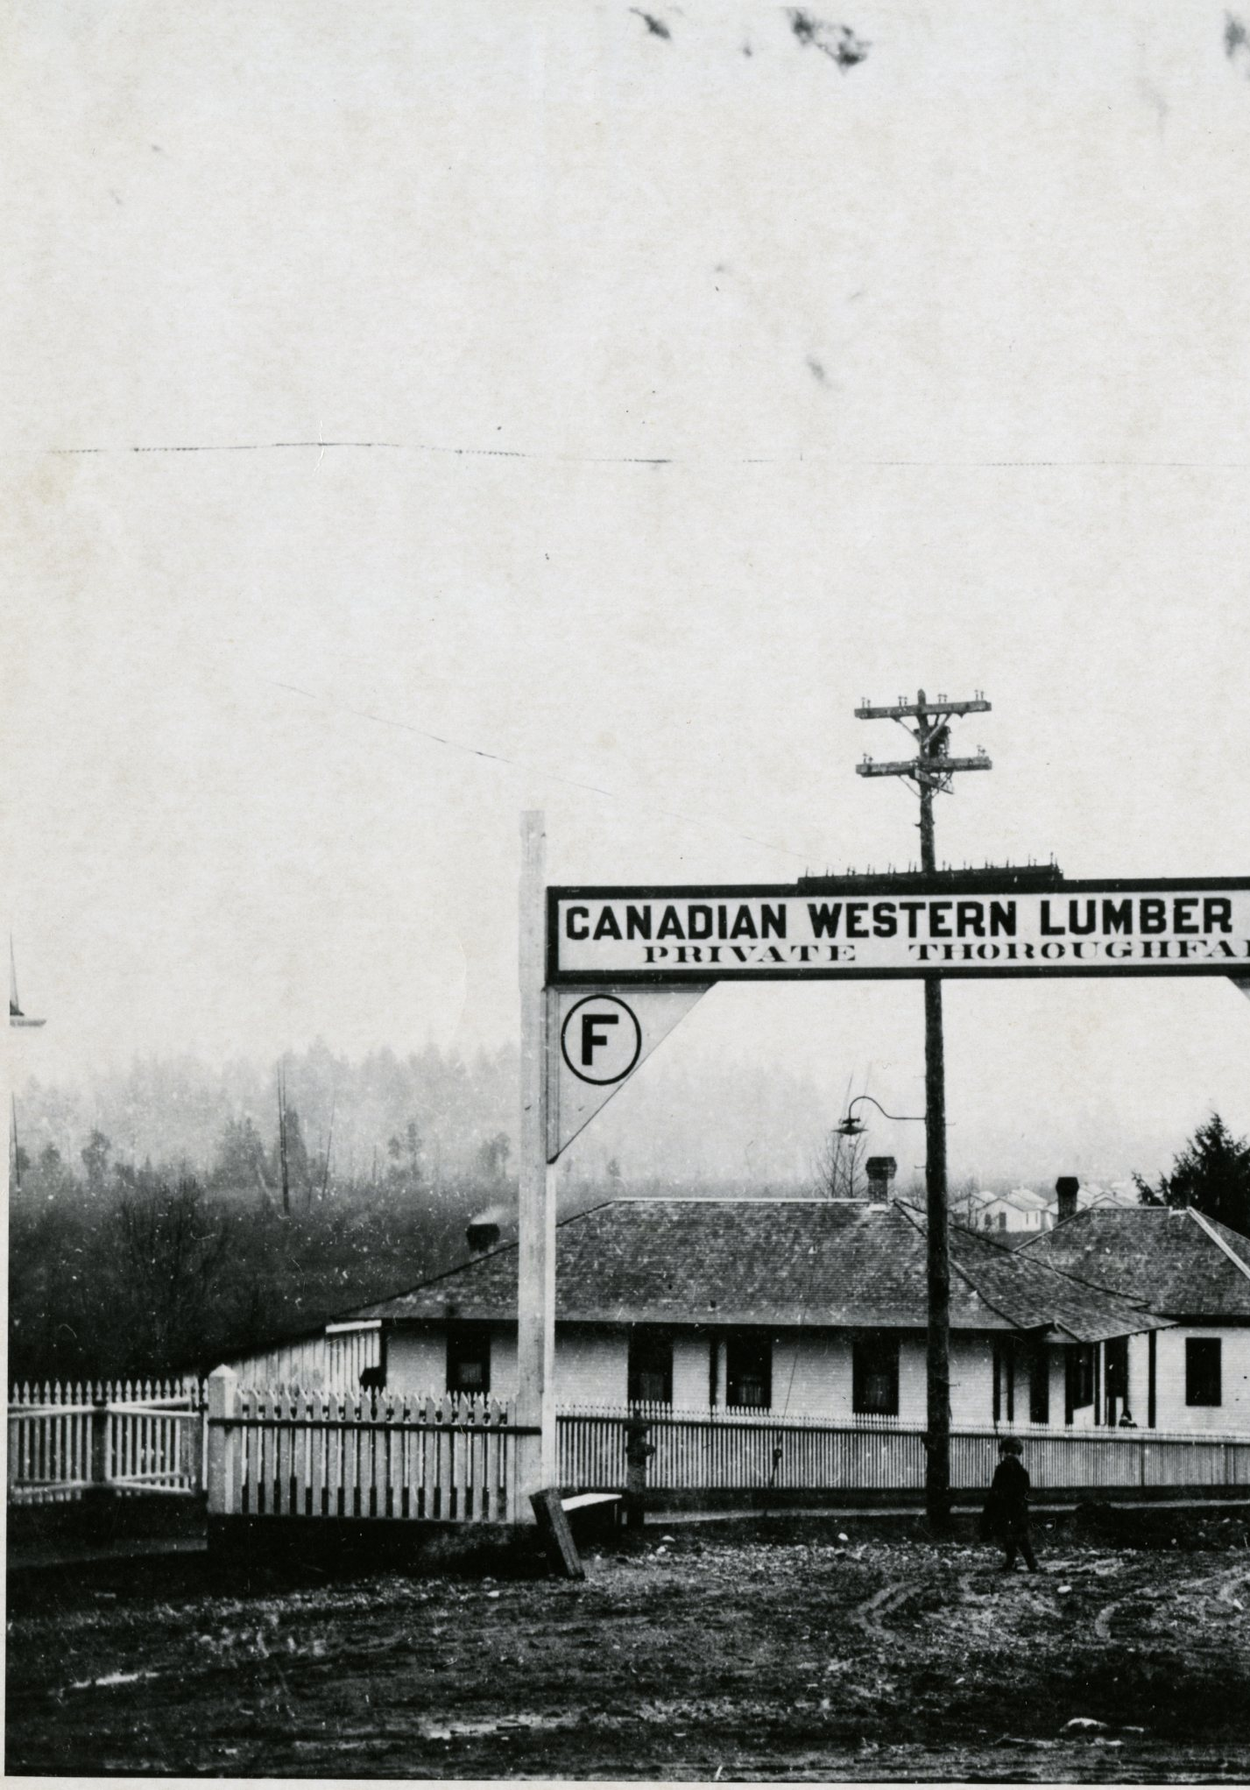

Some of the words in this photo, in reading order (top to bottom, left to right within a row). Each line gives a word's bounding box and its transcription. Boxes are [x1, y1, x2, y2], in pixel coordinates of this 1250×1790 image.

[566, 902, 787, 940] CANADIAN
[807, 899, 1017, 939] WESTERN
[1040, 896, 1233, 936] LUMBER
[644, 944, 857, 964] PRIVATE
[581, 1014, 619, 1066] F
